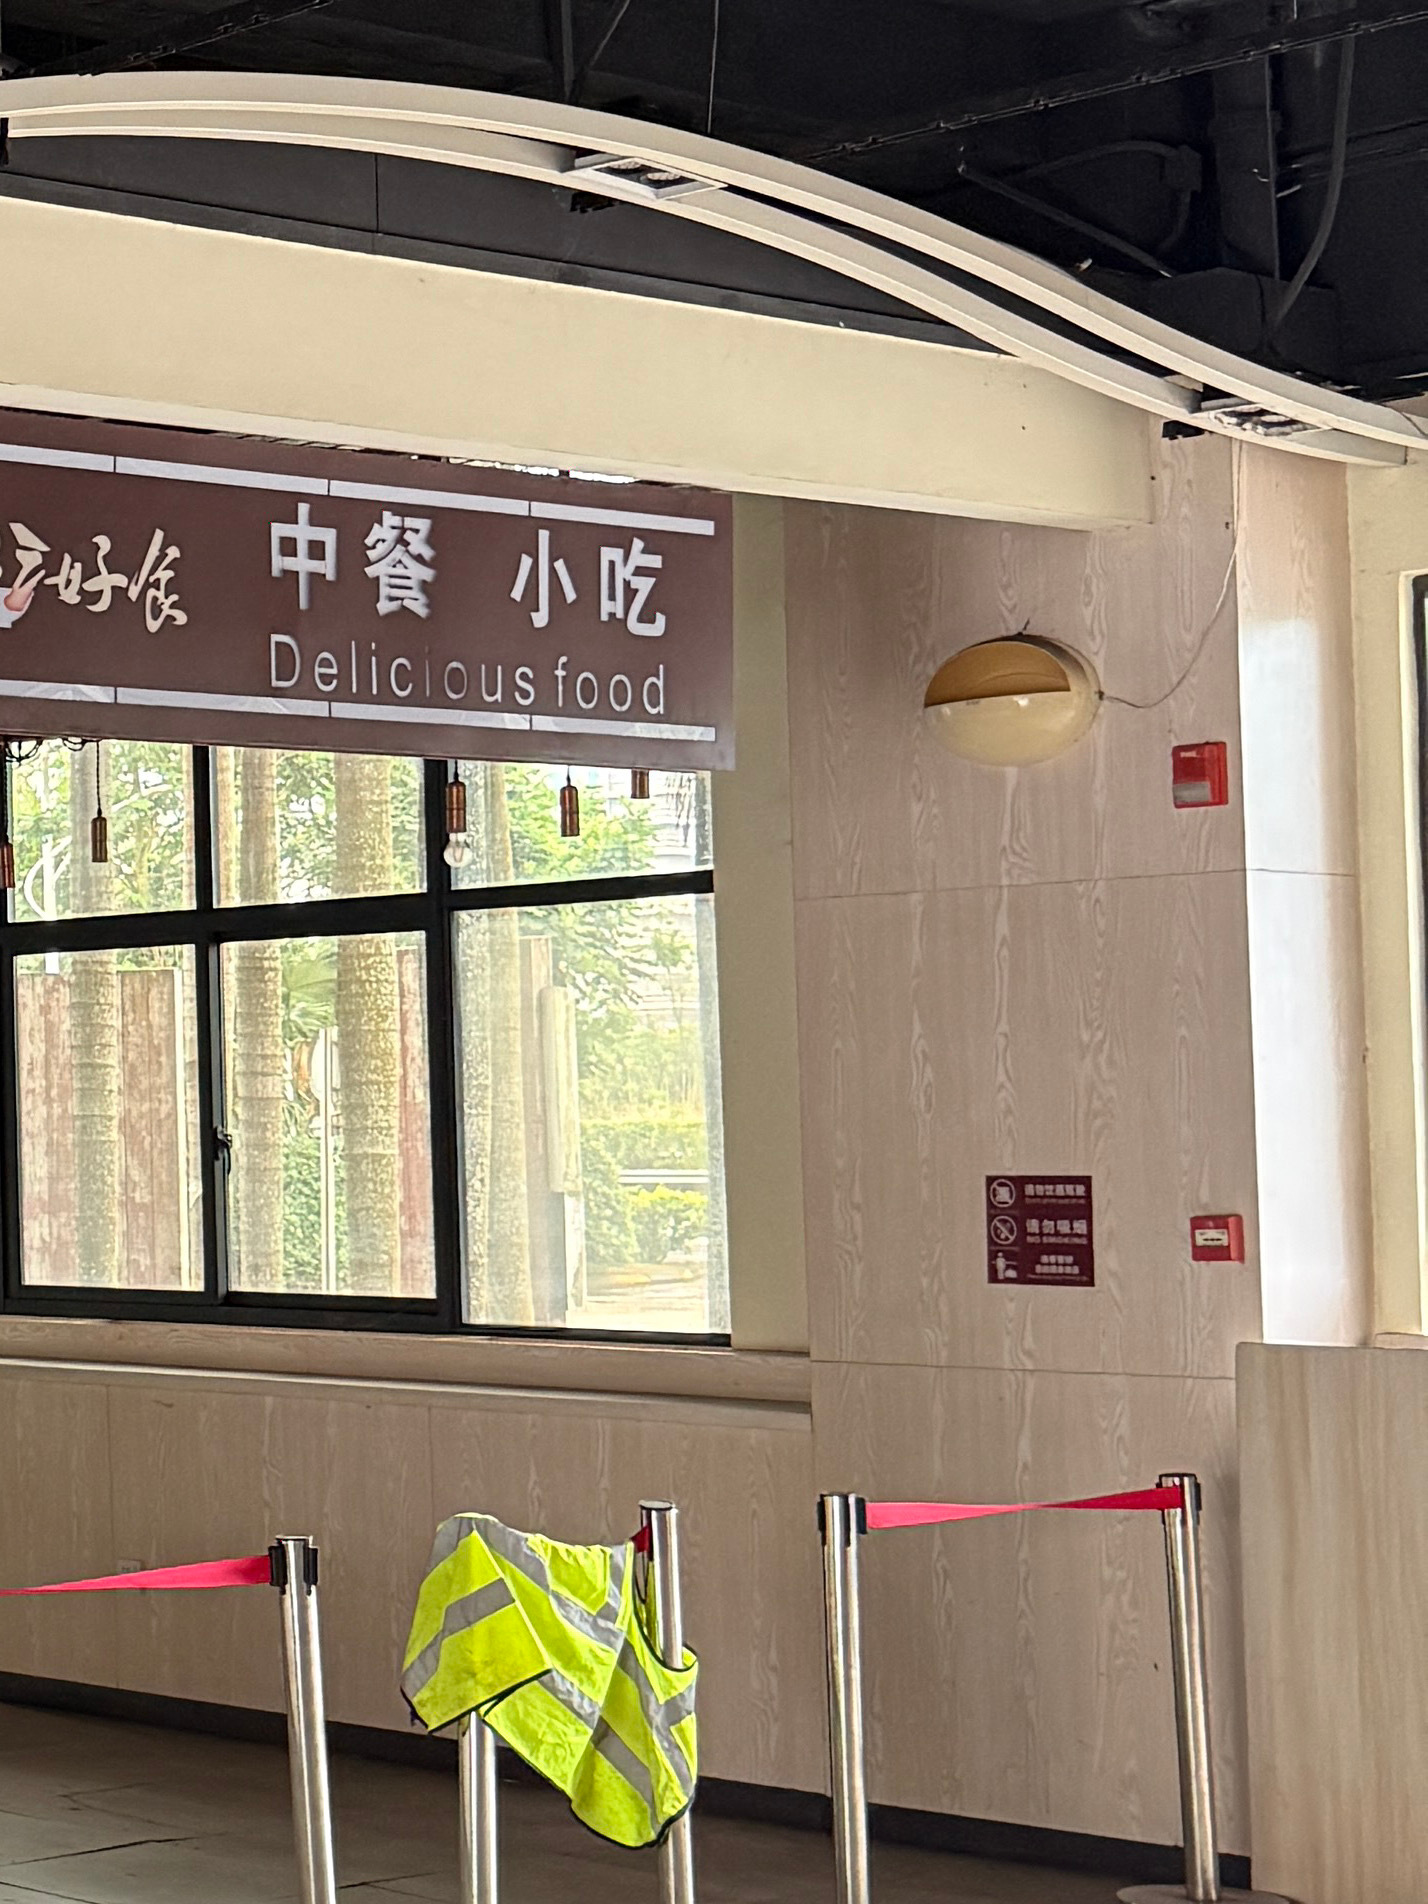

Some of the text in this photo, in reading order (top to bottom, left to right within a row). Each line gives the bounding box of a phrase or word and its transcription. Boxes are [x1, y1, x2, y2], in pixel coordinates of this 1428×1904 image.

[270, 502, 666, 637] 中餐 小吃
[270, 633, 665, 716] Delicious food
[1025, 1218, 1088, 1235] 请勿吸烟
